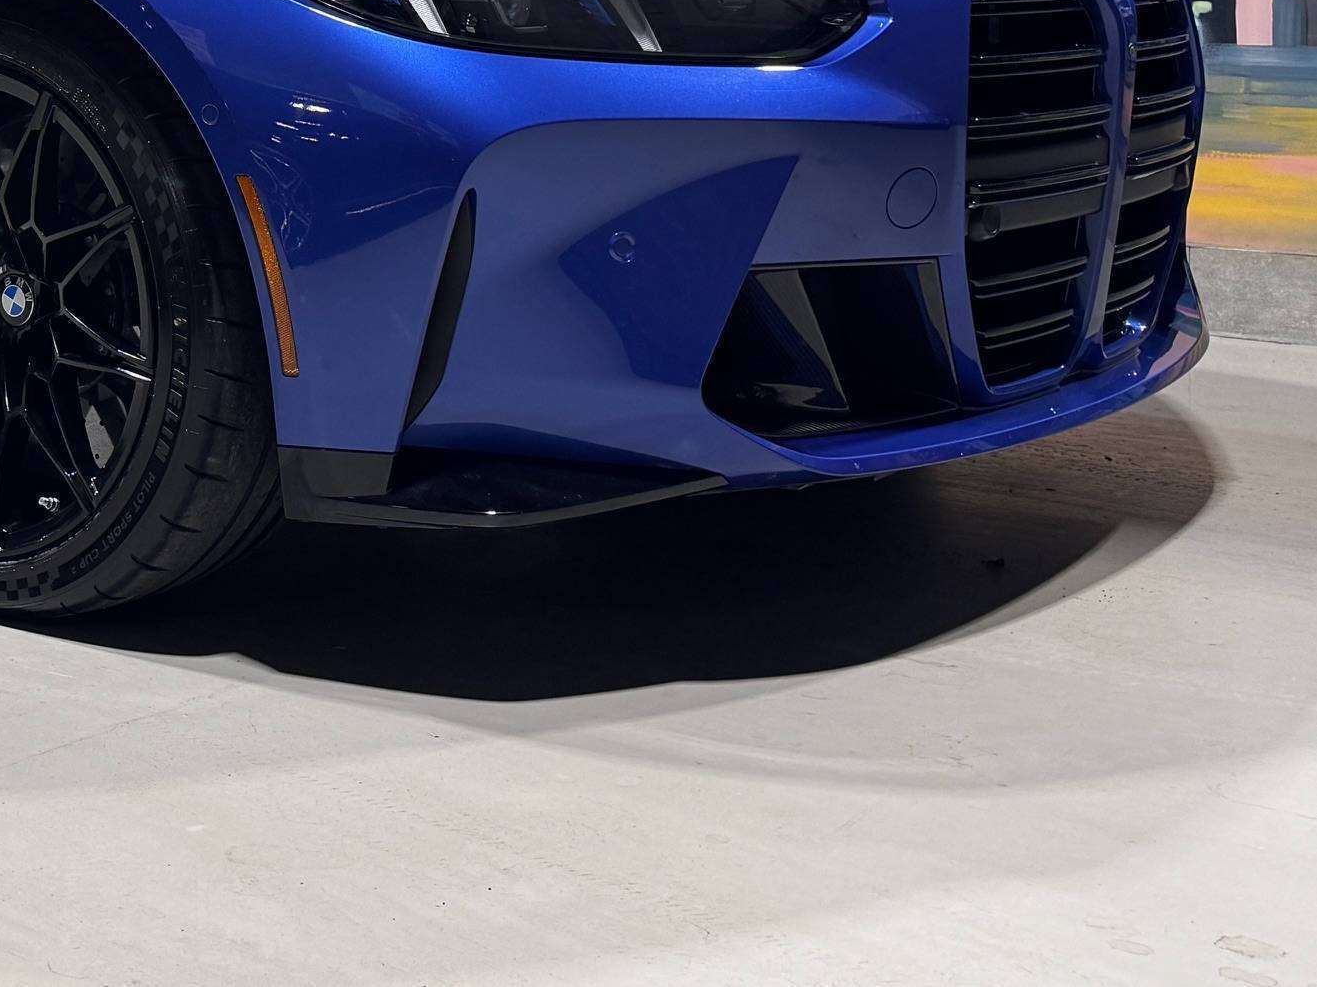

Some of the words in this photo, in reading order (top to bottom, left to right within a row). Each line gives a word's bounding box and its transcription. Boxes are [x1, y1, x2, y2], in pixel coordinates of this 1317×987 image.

[132, 471, 156, 513] PILOT
[101, 511, 133, 551] SPORT
[79, 547, 101, 569] CUP
